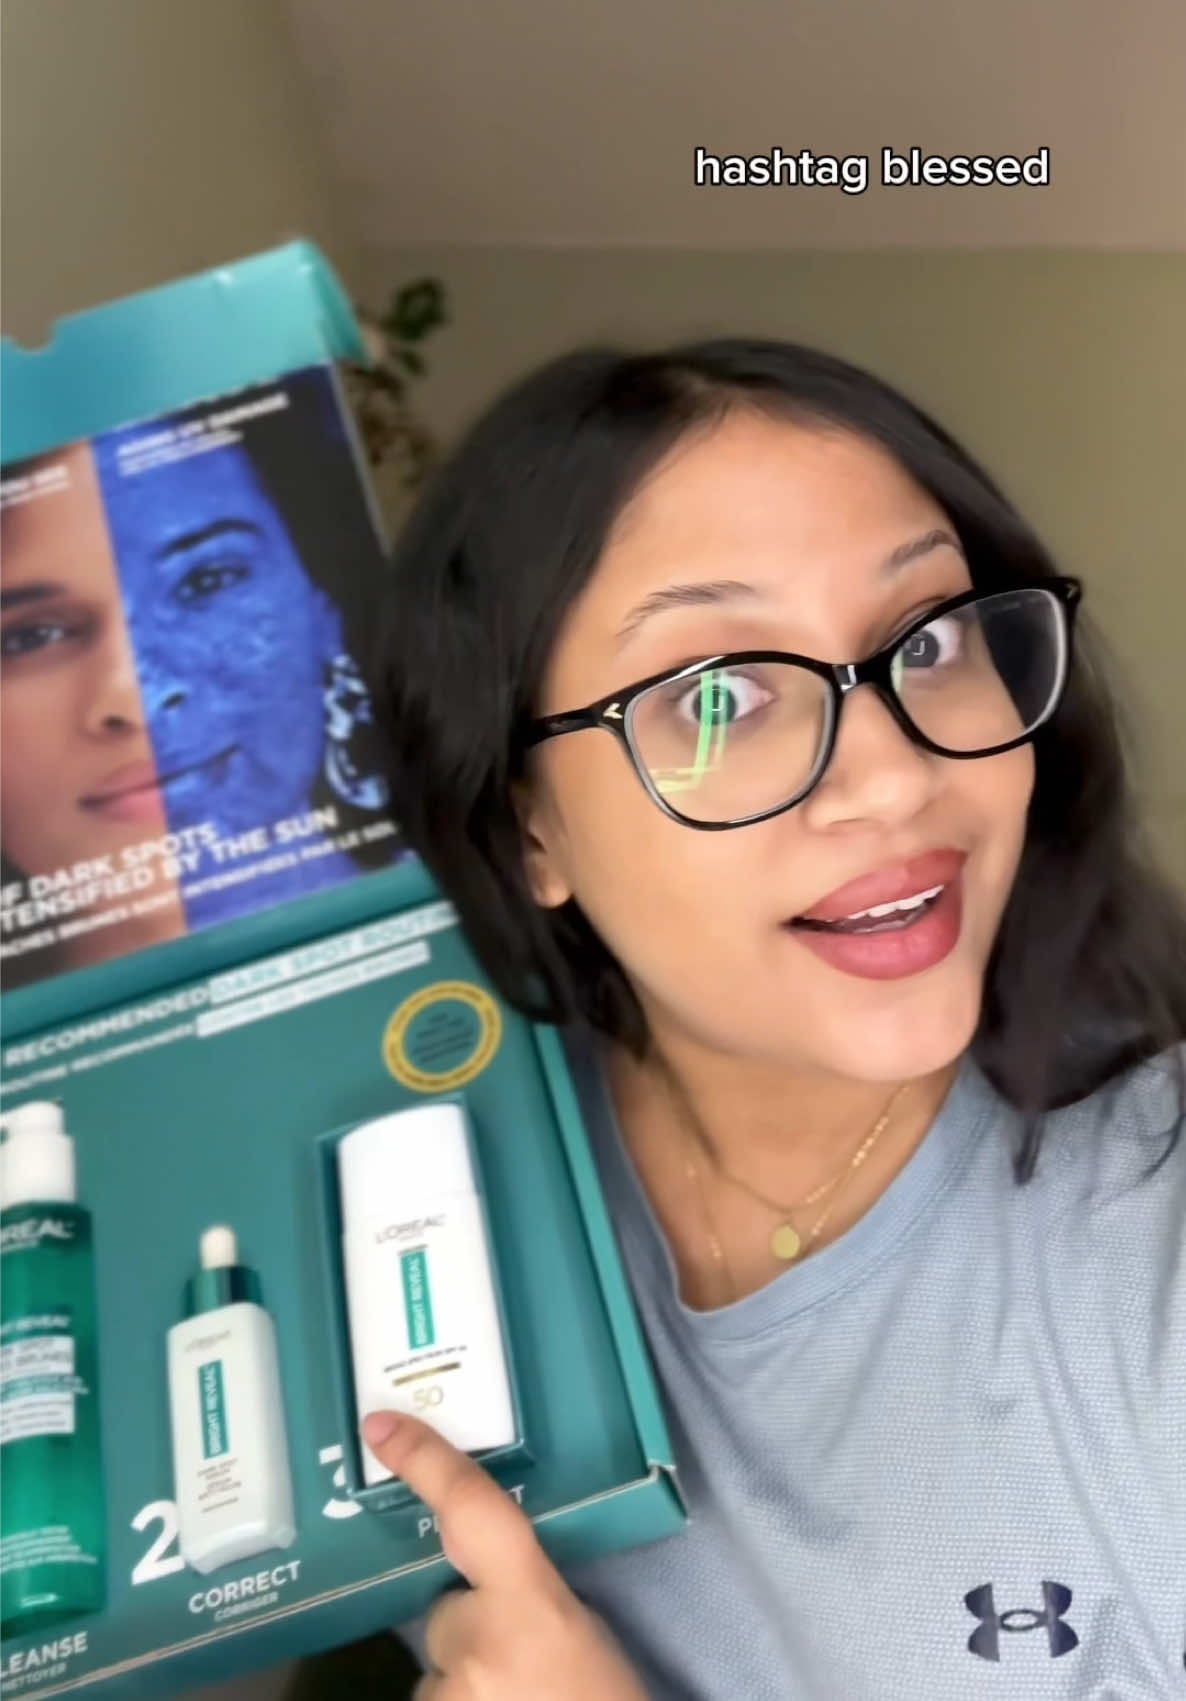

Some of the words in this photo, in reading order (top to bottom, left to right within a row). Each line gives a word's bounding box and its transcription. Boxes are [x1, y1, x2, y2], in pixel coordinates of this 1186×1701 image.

[0, 882, 22, 908] F
[29, 855, 114, 898] DARK
[120, 821, 217, 870] SPOTS
[162, 851, 200, 881] BY
[210, 827, 269, 864] THE
[275, 805, 338, 844] SUN
[5, 986, 209, 1067] RECOMMENDED
[413, 1385, 445, 1411] 50
[131, 1499, 187, 1586] 2
[188, 1560, 301, 1614] CORRECT
